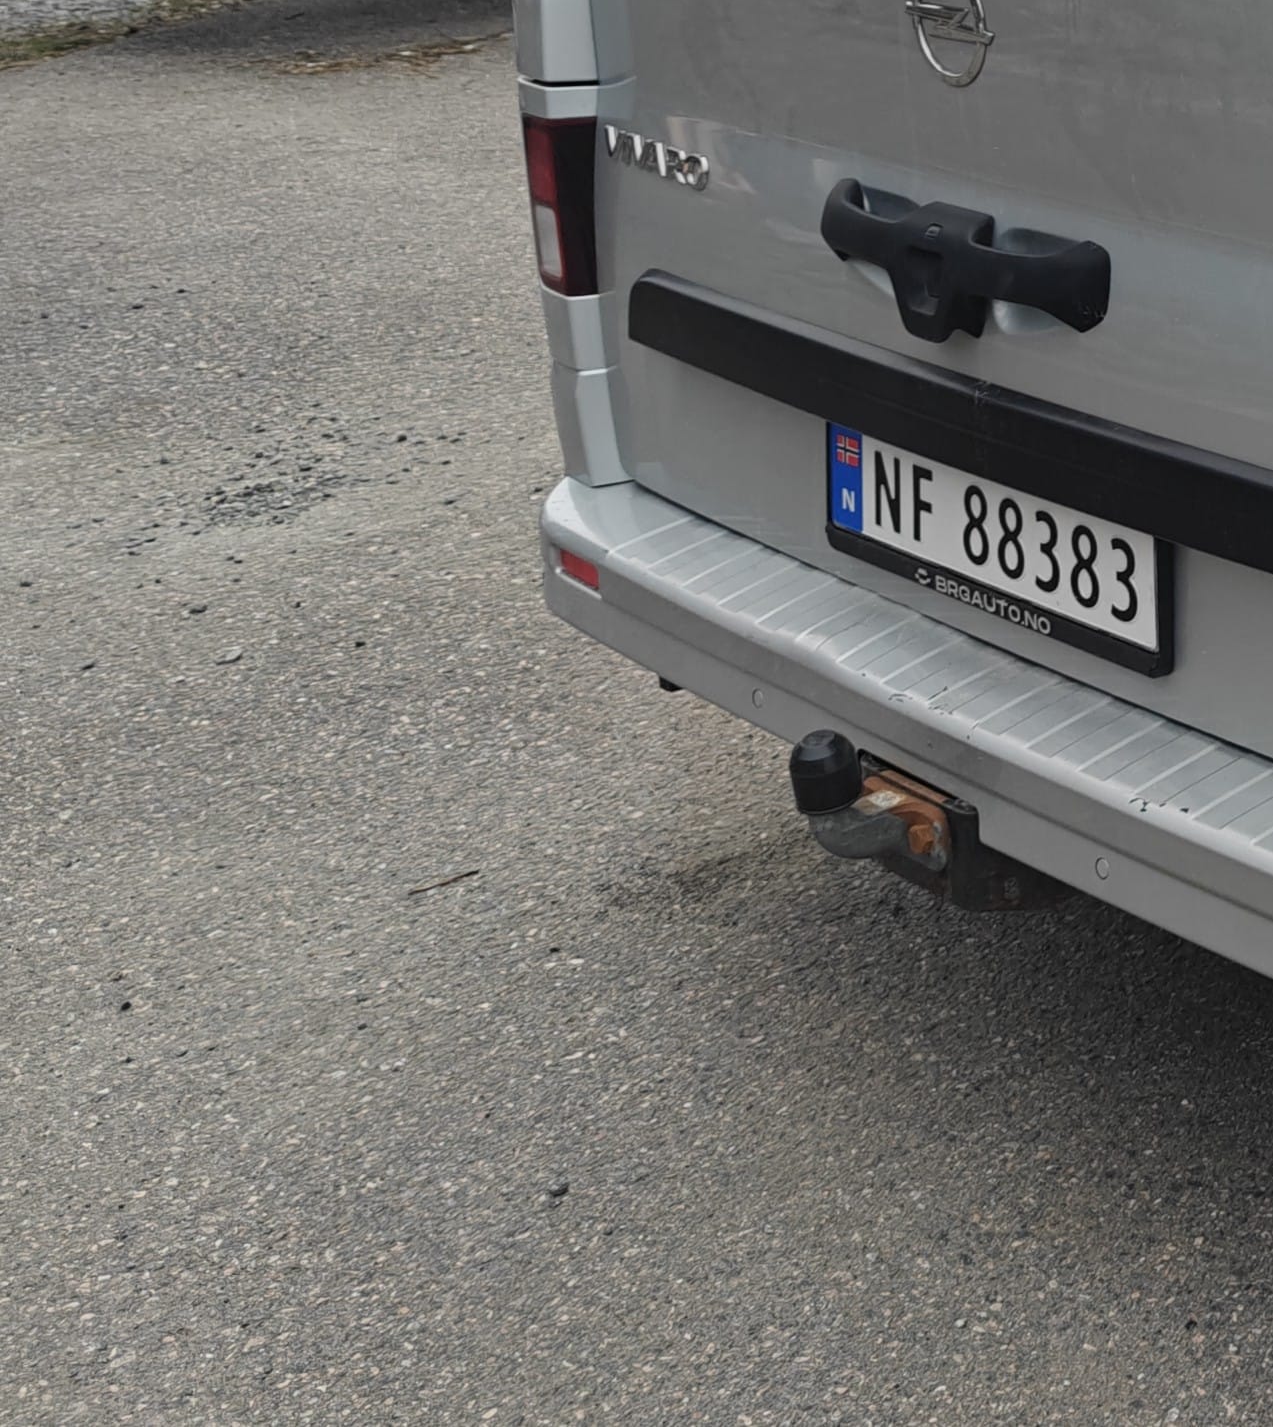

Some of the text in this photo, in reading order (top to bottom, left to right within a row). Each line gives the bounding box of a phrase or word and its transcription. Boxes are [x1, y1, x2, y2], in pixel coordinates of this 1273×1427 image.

[604, 124, 710, 192] VIVARO
[841, 487, 856, 513] N
[874, 450, 1139, 623] NF 88383
[934, 574, 1052, 636] BRGAUTO.NO
